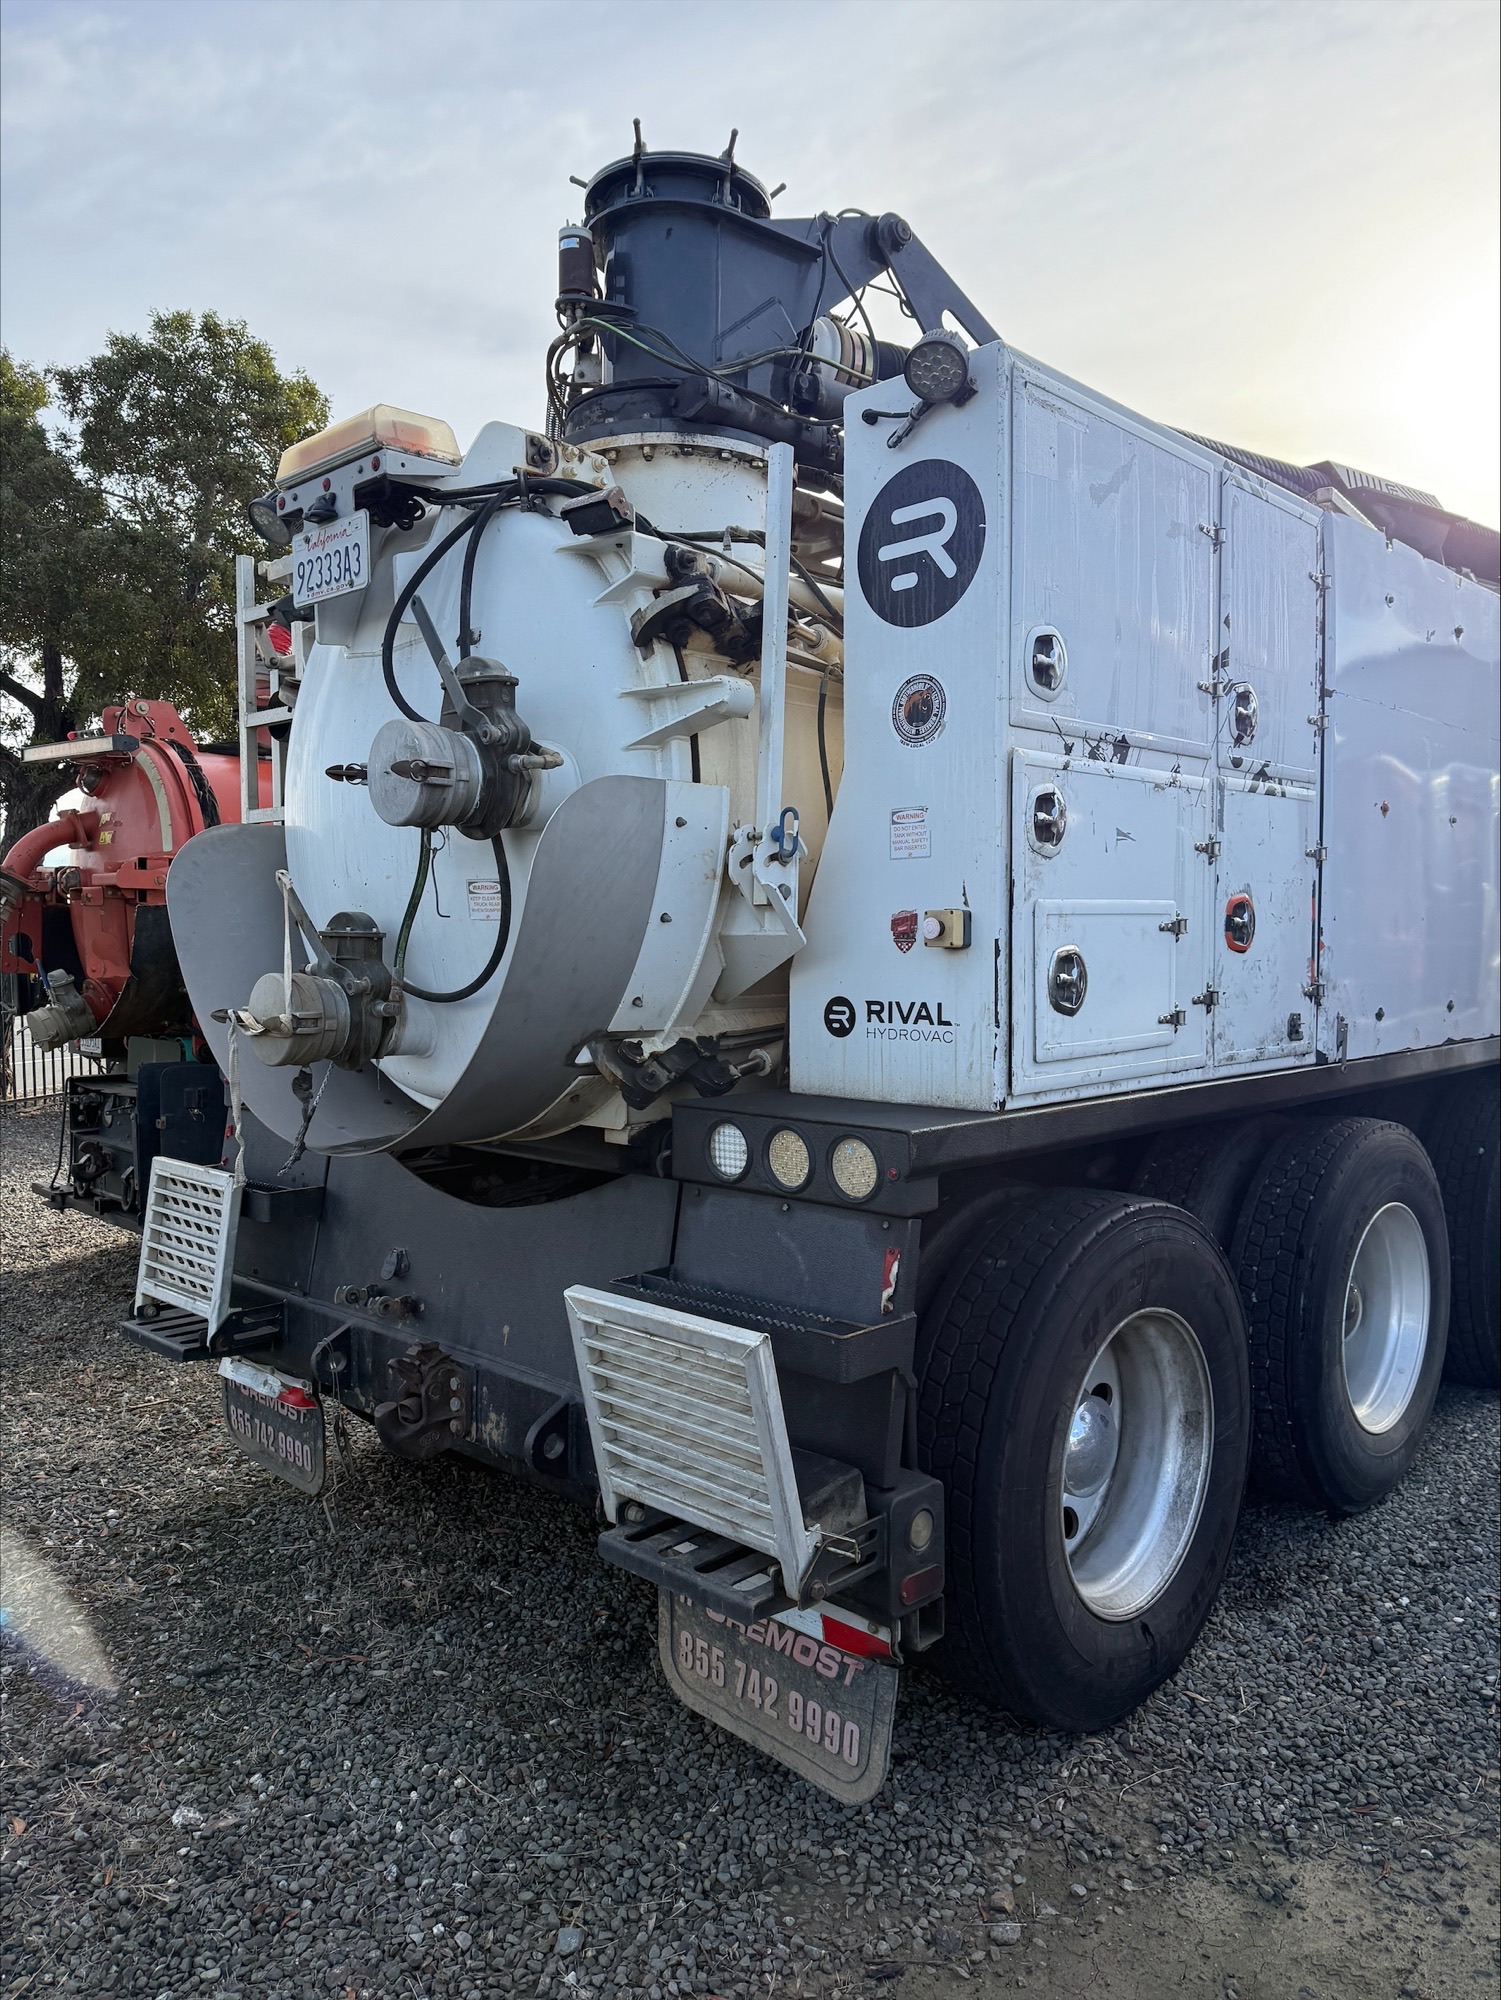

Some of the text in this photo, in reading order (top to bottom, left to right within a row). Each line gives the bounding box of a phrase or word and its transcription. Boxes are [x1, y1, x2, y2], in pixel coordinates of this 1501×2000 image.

[307, 528, 352, 552] California
[297, 542, 361, 595] 92333A3
[310, 582, 349, 598] dmv.ca.gov
[896, 812, 925, 820] WARNING
[865, 1000, 952, 1026] RIVAL
[866, 1027, 954, 1043] HYDROVAC
[230, 1405, 312, 1472] 855 742 9990
[680, 1630, 860, 1767] 855 742 9990
